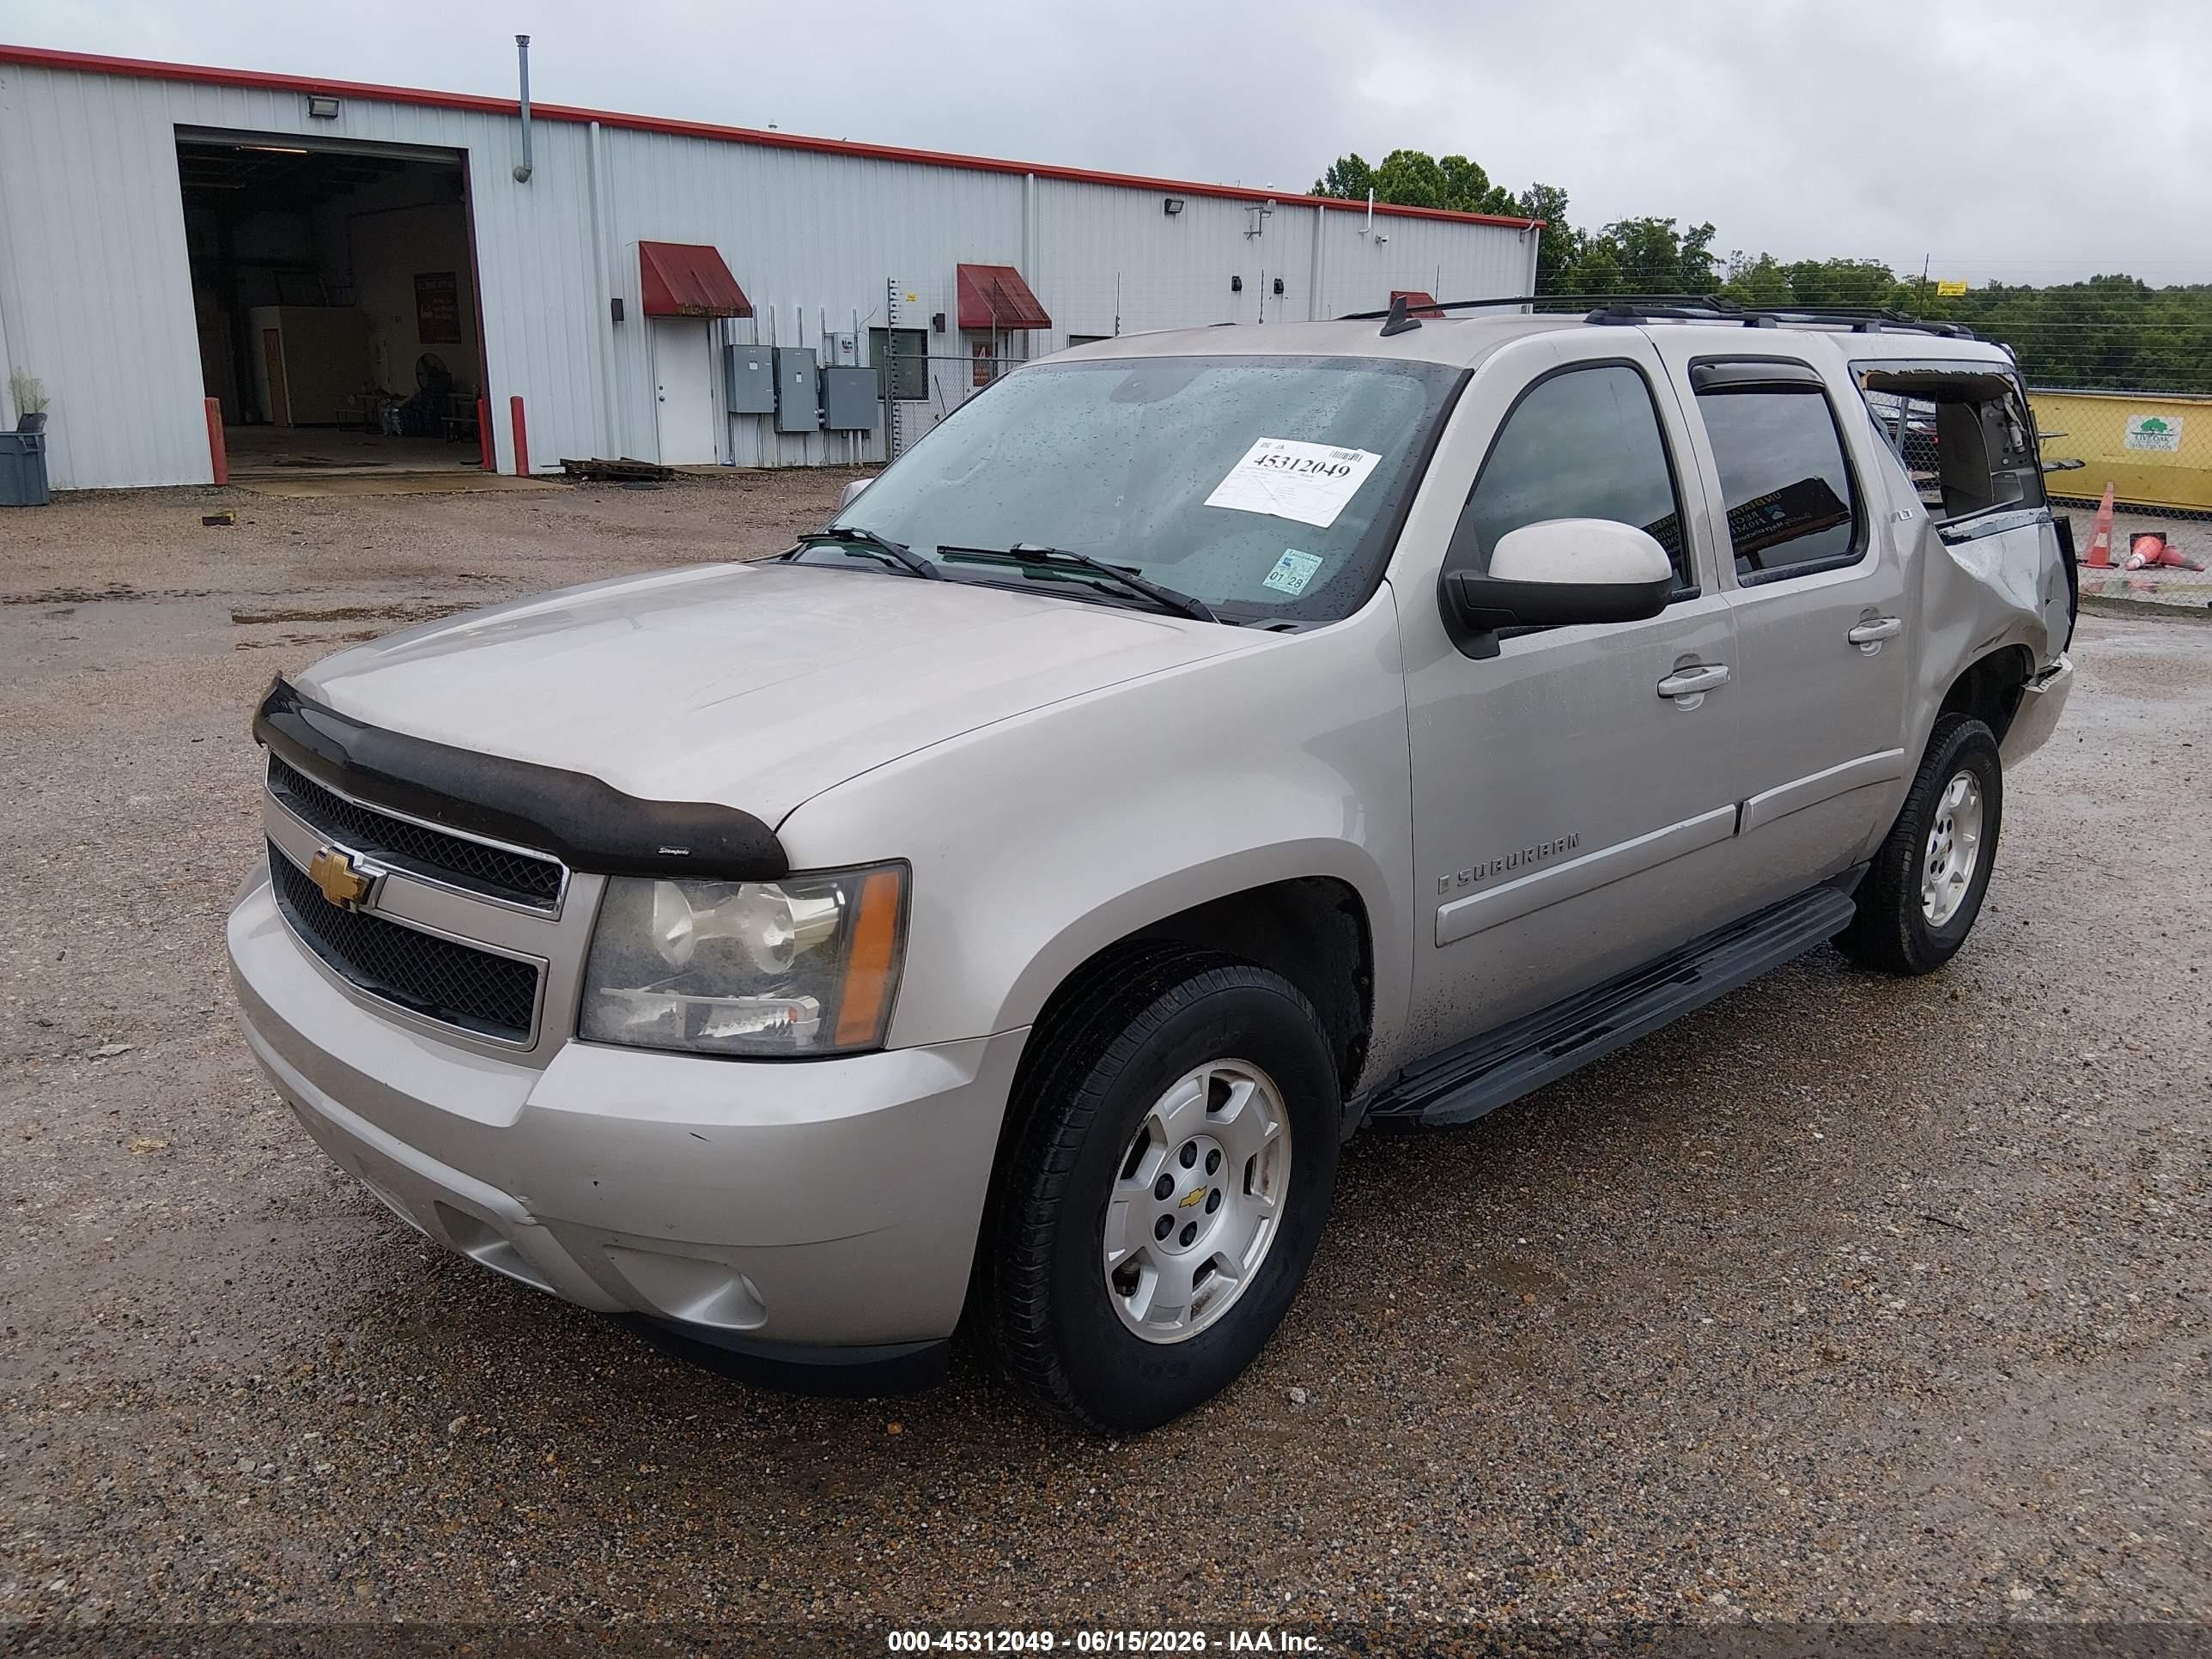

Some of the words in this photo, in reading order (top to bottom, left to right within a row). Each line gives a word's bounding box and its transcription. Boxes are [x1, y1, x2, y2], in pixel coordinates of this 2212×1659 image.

[1254, 453, 1351, 478] 45312049
[1897, 508, 1913, 521] LT
[1270, 571, 1284, 582] 01
[1287, 576, 1304, 588] 28
[1457, 831, 1581, 887] SUBURBAN
